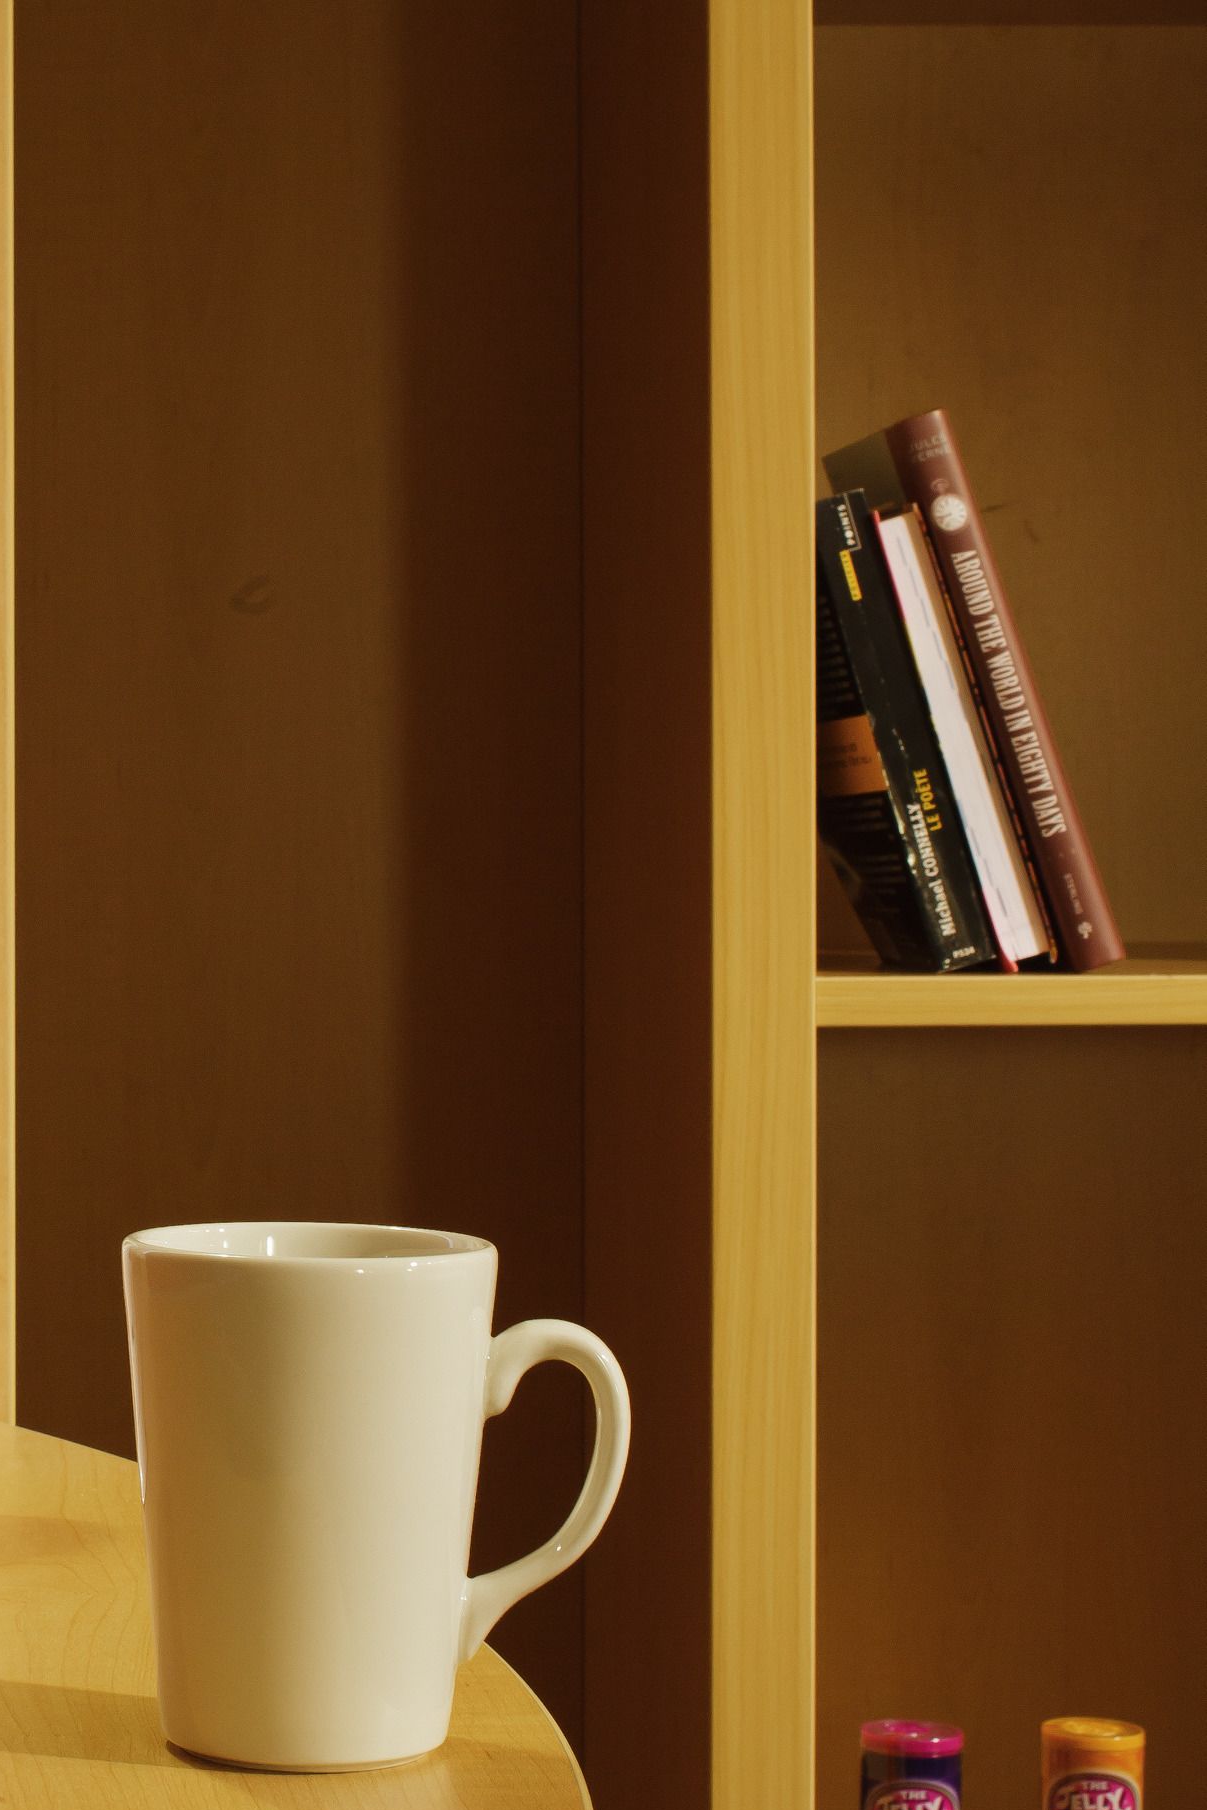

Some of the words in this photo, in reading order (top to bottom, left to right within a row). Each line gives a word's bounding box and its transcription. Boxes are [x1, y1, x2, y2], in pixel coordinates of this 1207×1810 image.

[950, 549, 995, 617] AROUND
[973, 613, 1007, 654] THE
[985, 650, 1027, 712] WORLD
[1004, 708, 1033, 733] IN
[1010, 731, 1054, 796] EIGHTY
[906, 803, 938, 876] CONNELLY
[927, 812, 943, 831] LE
[1032, 795, 1067, 838] DAYS
[929, 879, 956, 936] Michael
